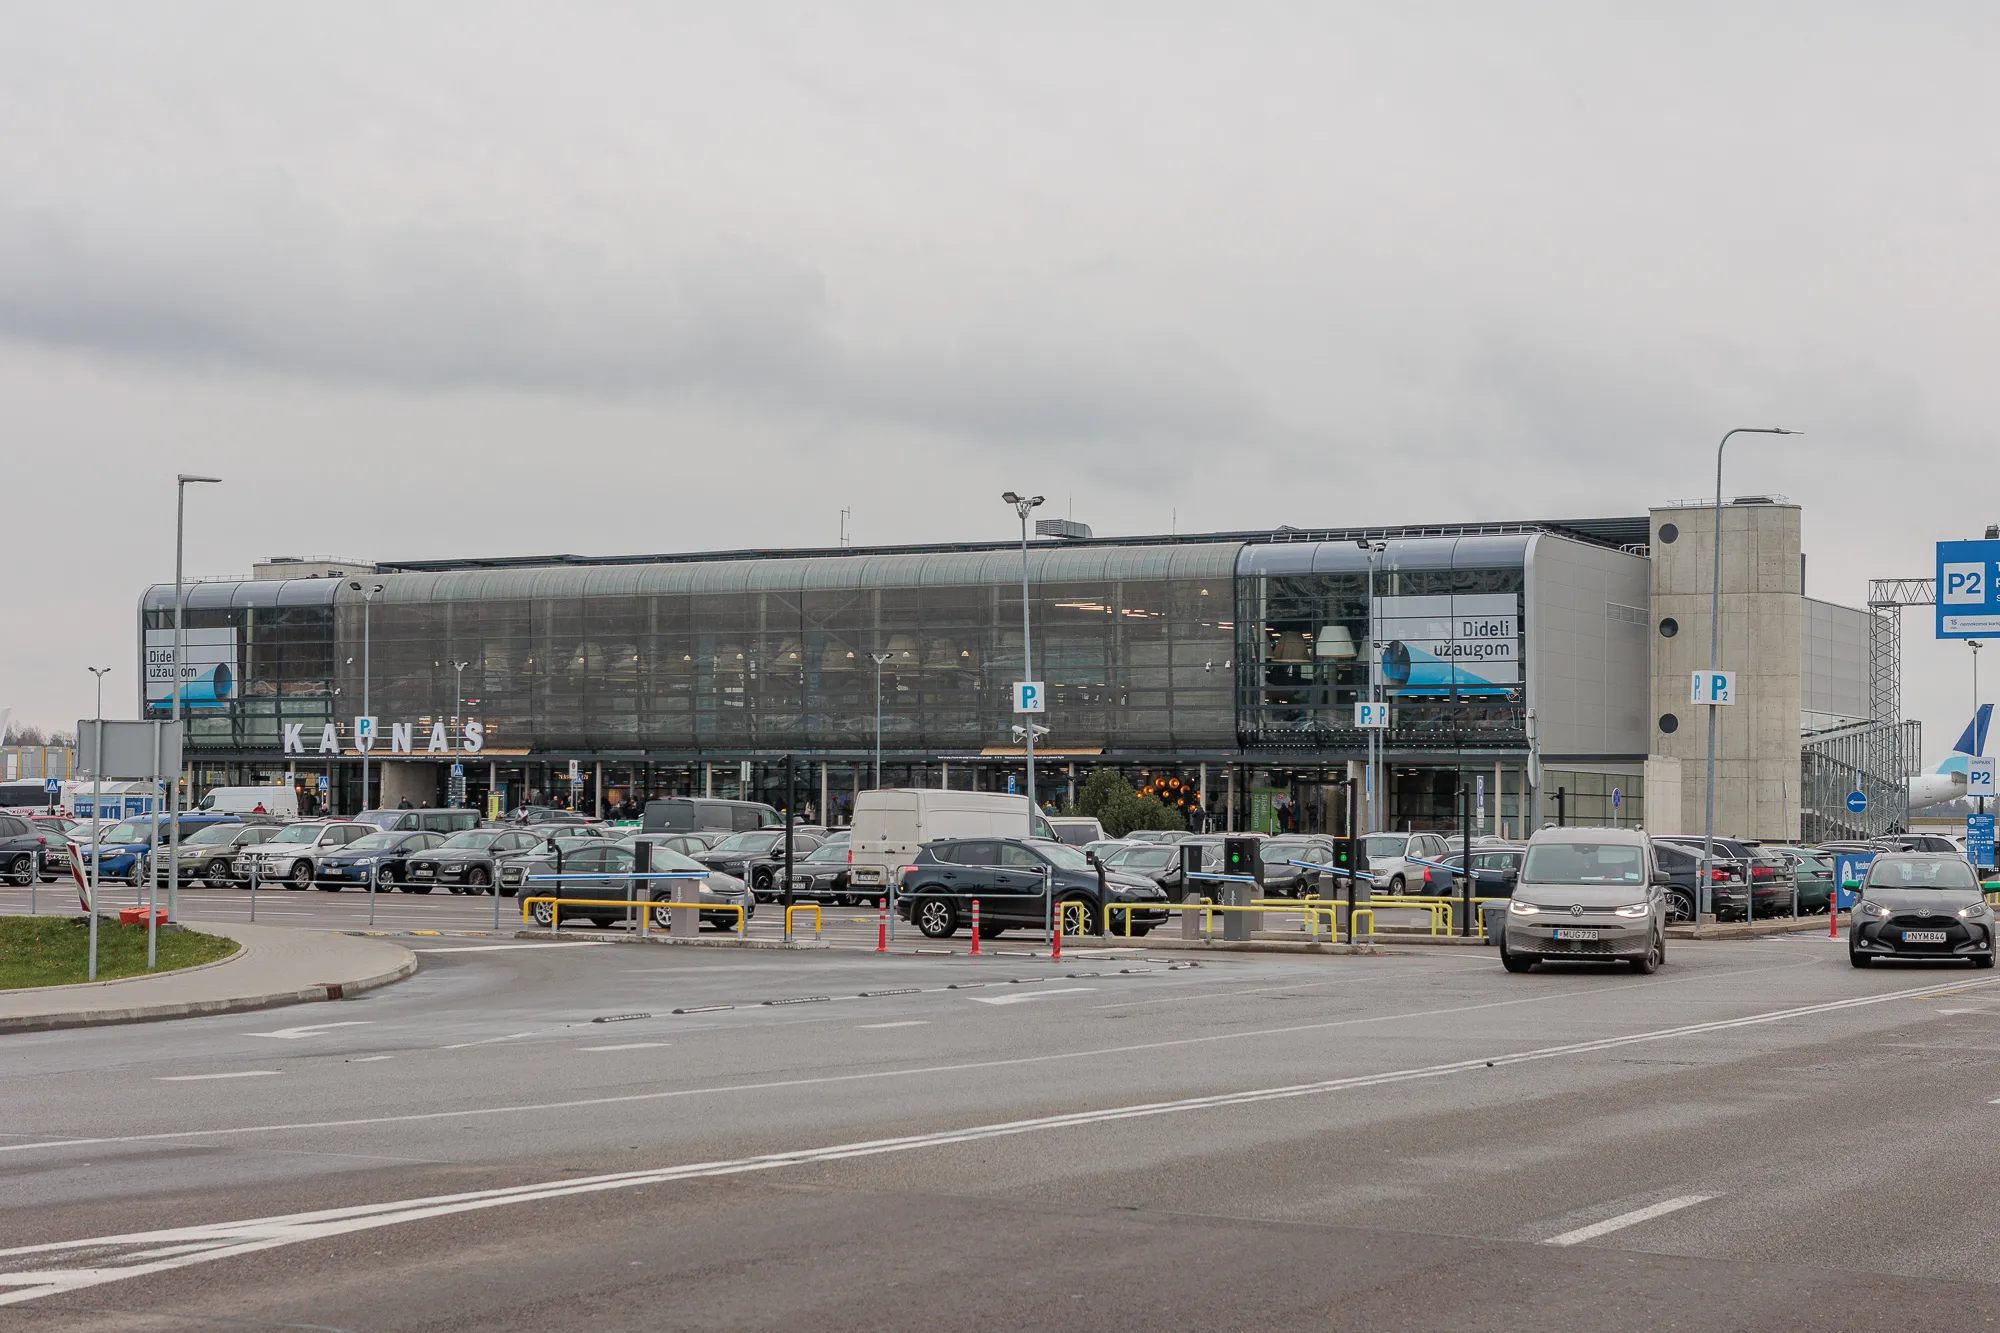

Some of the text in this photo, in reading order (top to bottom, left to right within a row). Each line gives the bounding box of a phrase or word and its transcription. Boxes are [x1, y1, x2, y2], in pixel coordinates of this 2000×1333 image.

[1948, 572, 1981, 594] P2
[1463, 620, 1509, 636] Dideli
[150, 650, 175, 662] Didel
[1434, 640, 1509, 660] užaugom
[150, 664, 197, 677] užauom
[1711, 675, 1728, 701] P2
[1022, 686, 1038, 708] P2
[1361, 705, 1372, 724] P2
[360, 719, 371, 735] P2
[1971, 771, 1991, 785] P2
[1563, 931, 1597, 939] MUG778
[1911, 932, 1945, 940] NYM844
